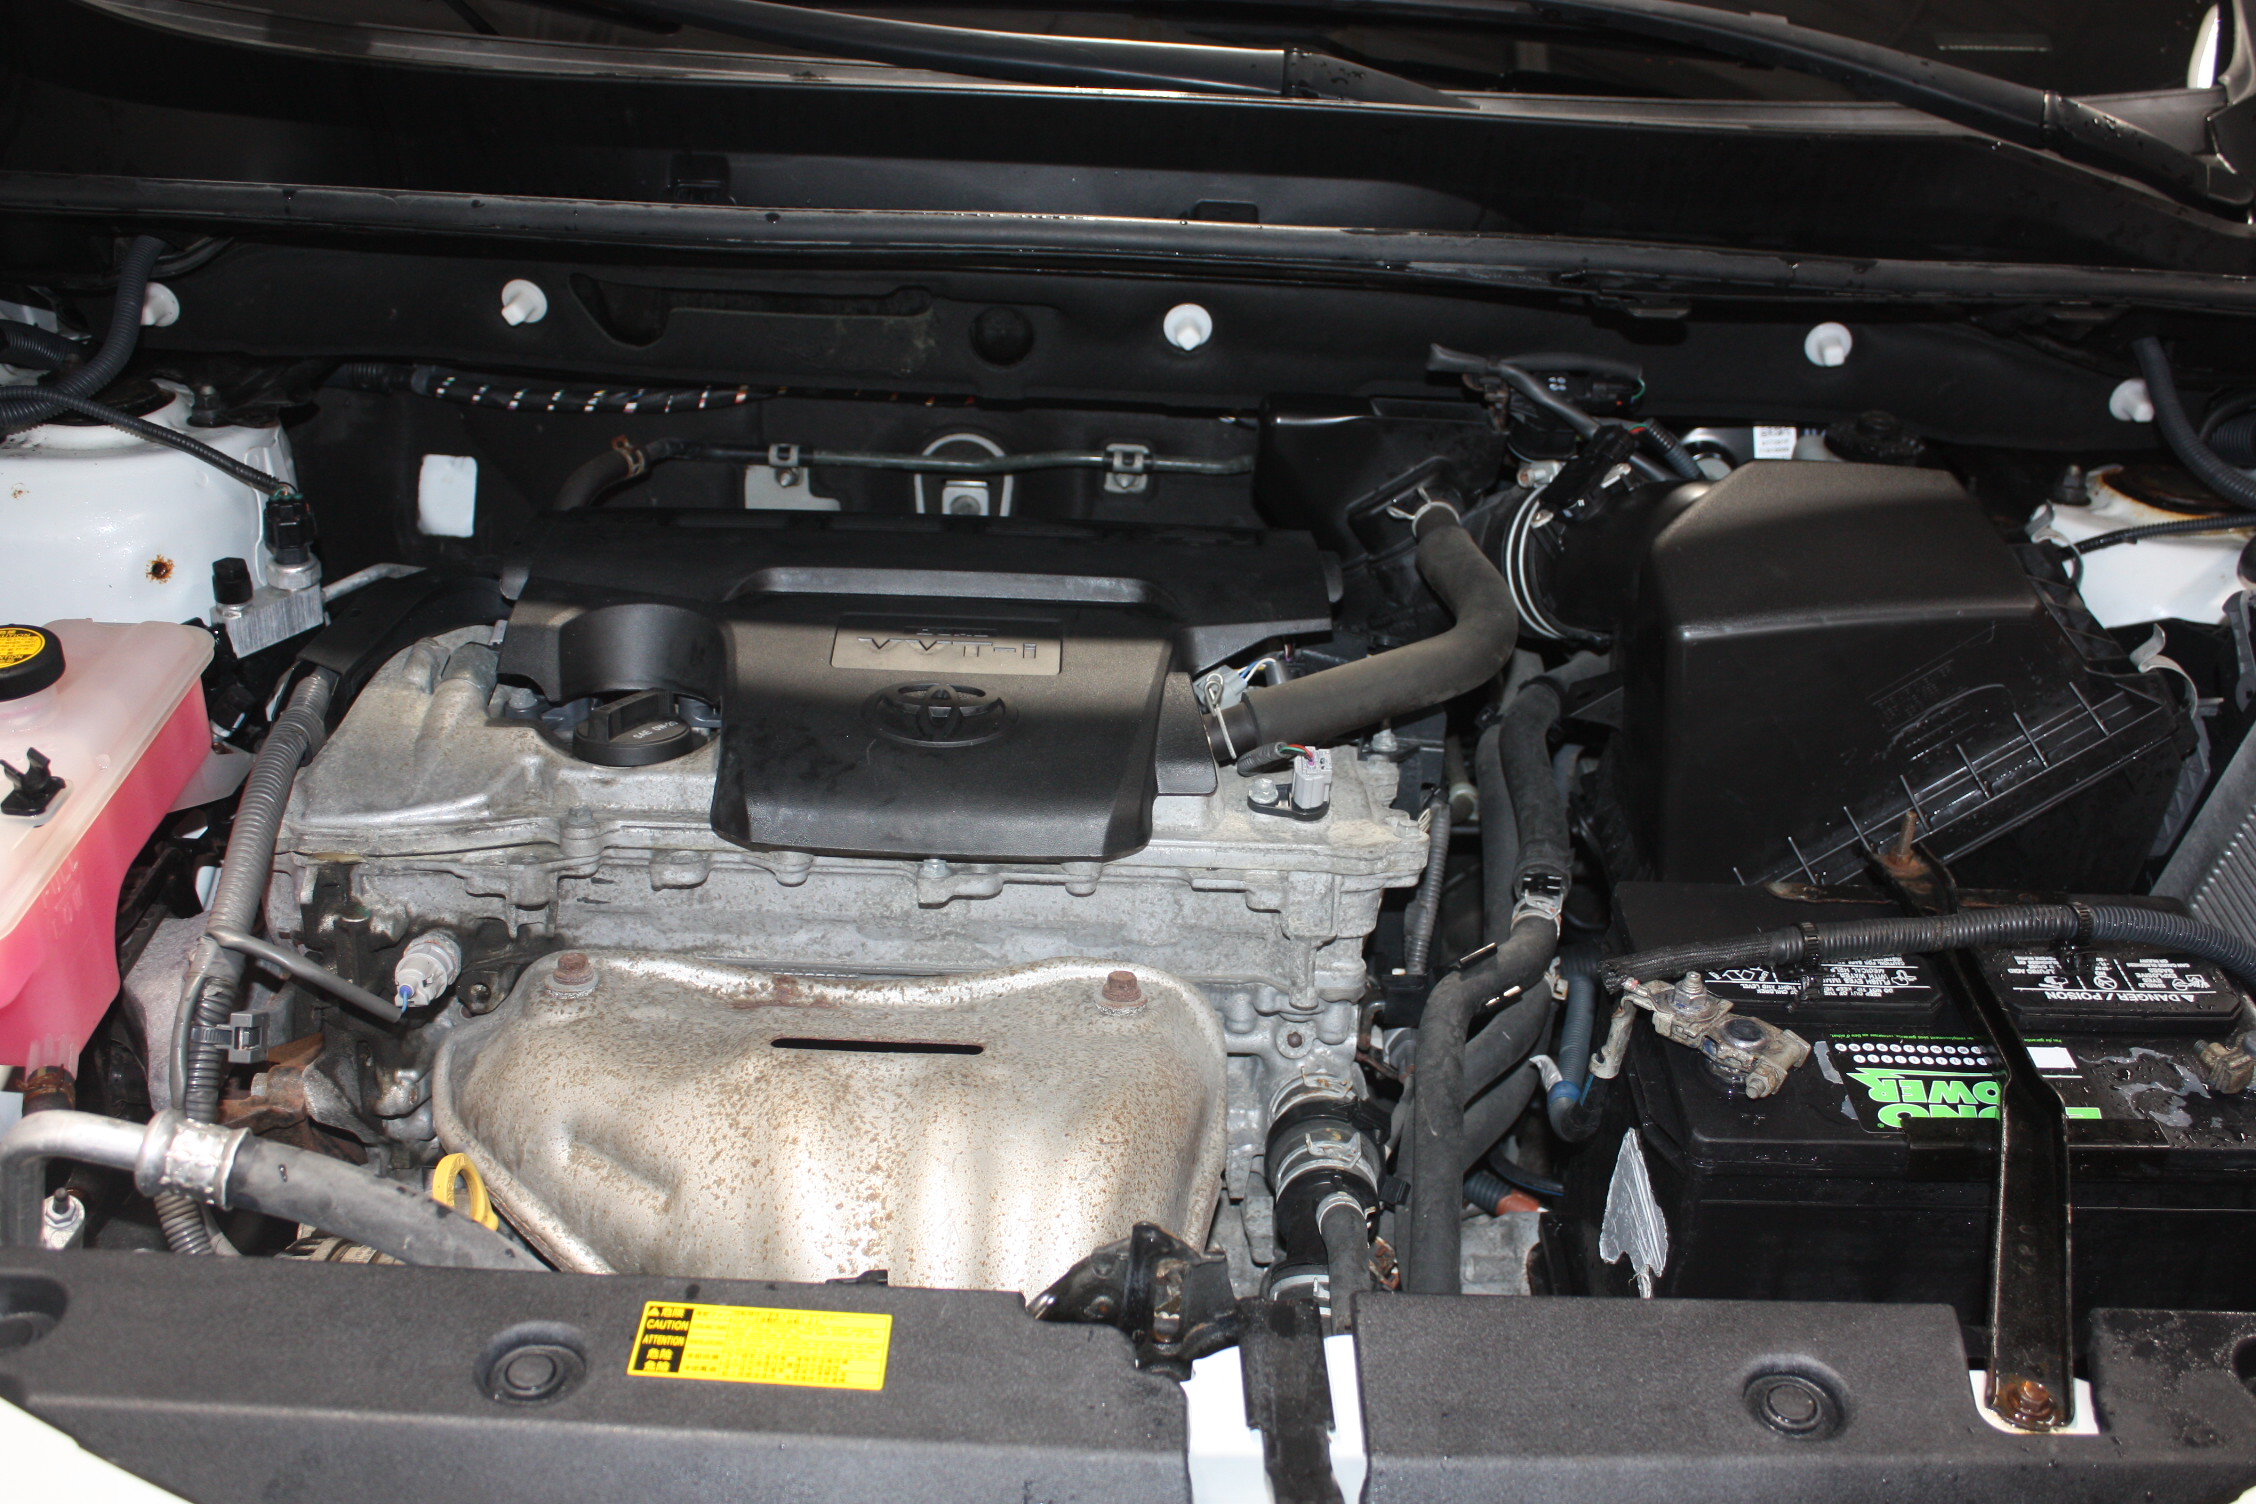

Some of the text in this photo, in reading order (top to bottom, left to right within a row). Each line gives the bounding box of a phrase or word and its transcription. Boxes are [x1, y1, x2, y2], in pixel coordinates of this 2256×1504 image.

[2044, 991, 2104, 1001] POISON
[2116, 993, 2181, 1002] DANGER
[1866, 1079, 2002, 1105] OWER
[646, 1319, 690, 1332] CAUTION
[641, 1333, 686, 1347] ATTENTION
